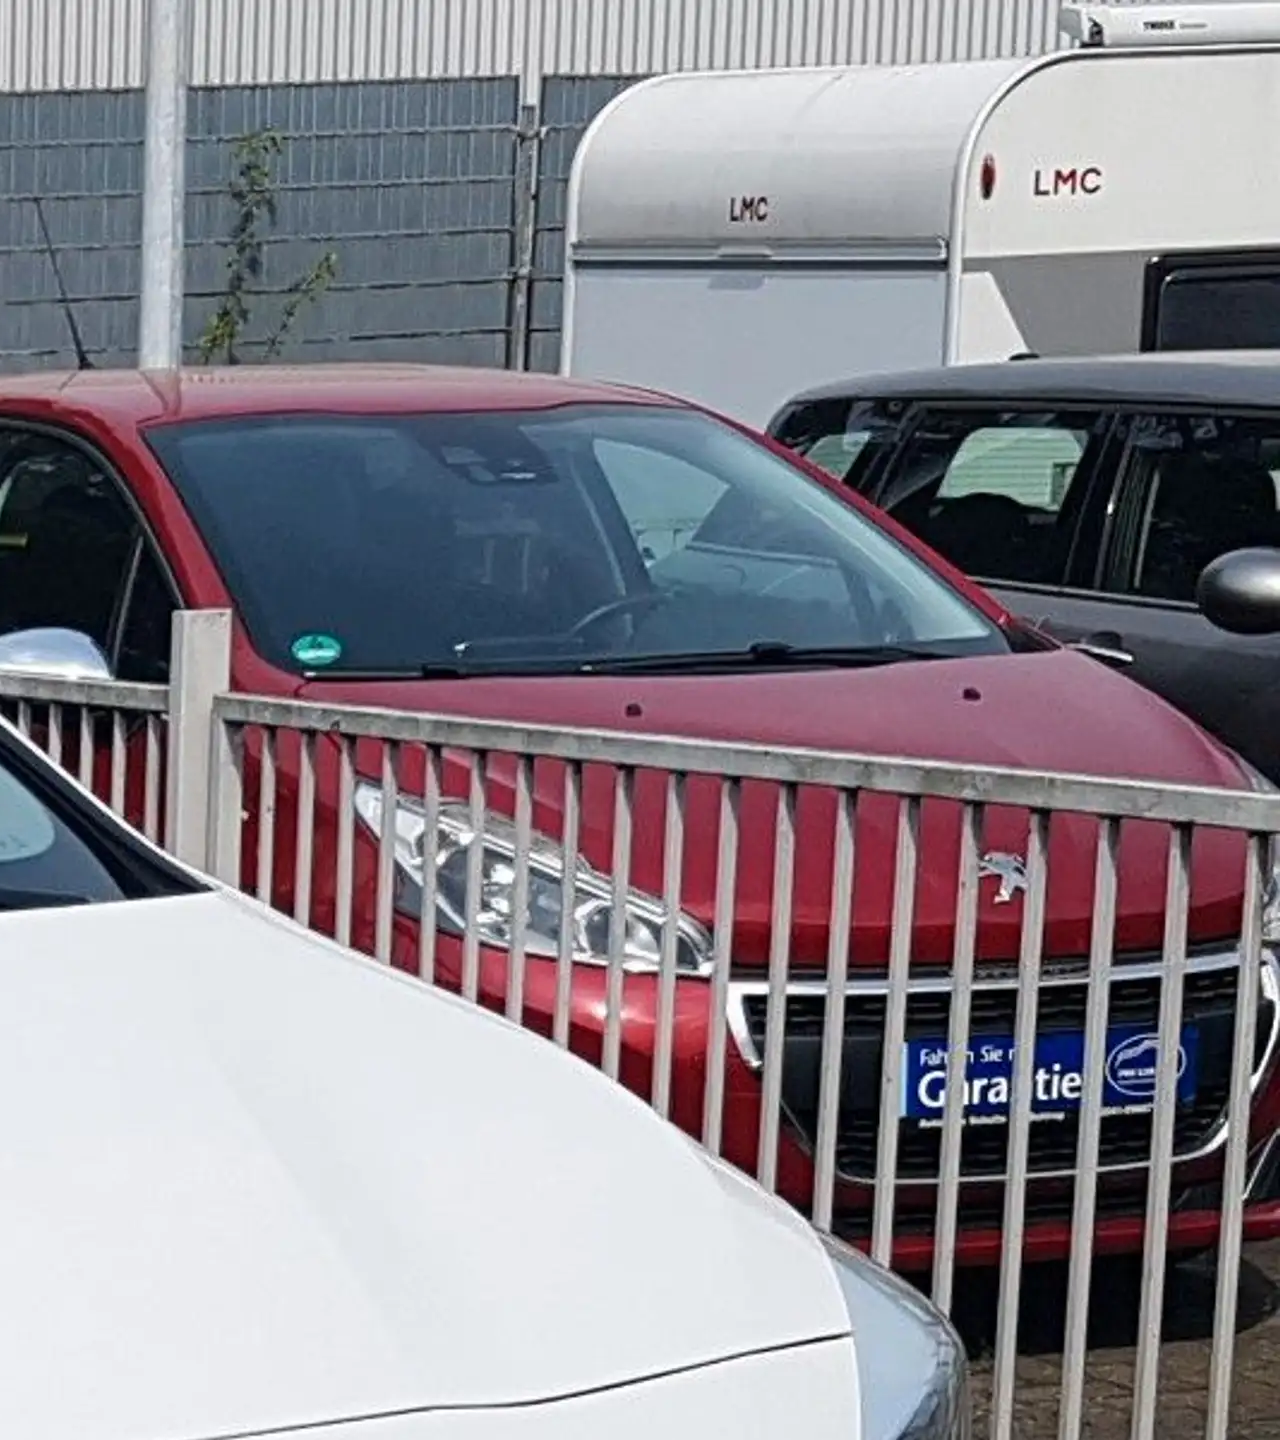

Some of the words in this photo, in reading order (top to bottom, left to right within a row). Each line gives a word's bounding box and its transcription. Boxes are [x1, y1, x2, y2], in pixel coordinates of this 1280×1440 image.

[1032, 167, 1103, 196] LMC
[729, 197, 770, 222] LMC
[980, 1044, 1004, 1063] Sie
[917, 1063, 1083, 1108] Gratie
